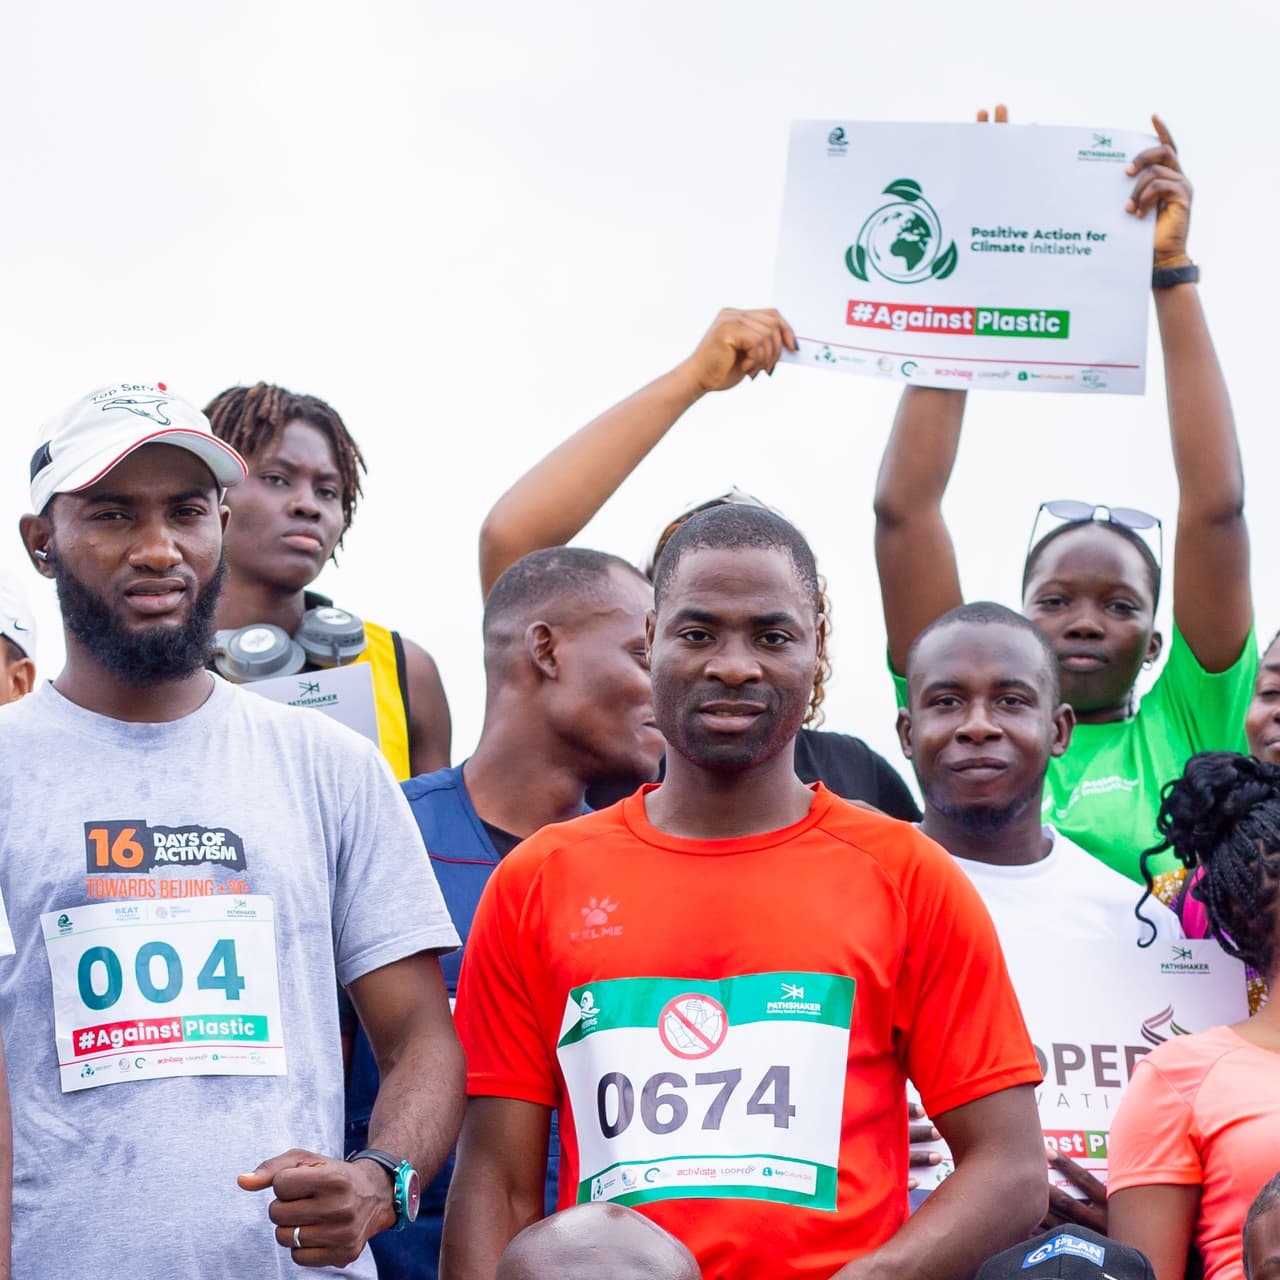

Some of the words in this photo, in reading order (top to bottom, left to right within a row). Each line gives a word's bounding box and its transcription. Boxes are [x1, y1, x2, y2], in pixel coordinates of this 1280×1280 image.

[971, 226, 1029, 240] Positive
[1033, 228, 1082, 241] Action
[1085, 229, 1108, 242] for
[970, 240, 1026, 254] Climate
[851, 302, 972, 331] #Against
[978, 310, 1061, 333] Plastic
[87, 827, 145, 868] 16
[153, 832, 200, 847] DAYS
[202, 832, 225, 844] OF
[154, 846, 237, 862] ACTIVISM
[86, 878, 156, 899] TOWARDS
[160, 879, 214, 898] BEIJING
[77, 938, 246, 1011] 004
[78, 1019, 181, 1050] #Against
[186, 1017, 256, 1037] Plastic
[597, 1065, 797, 1139] 0674
[1054, 1236, 1101, 1258] PLAN
